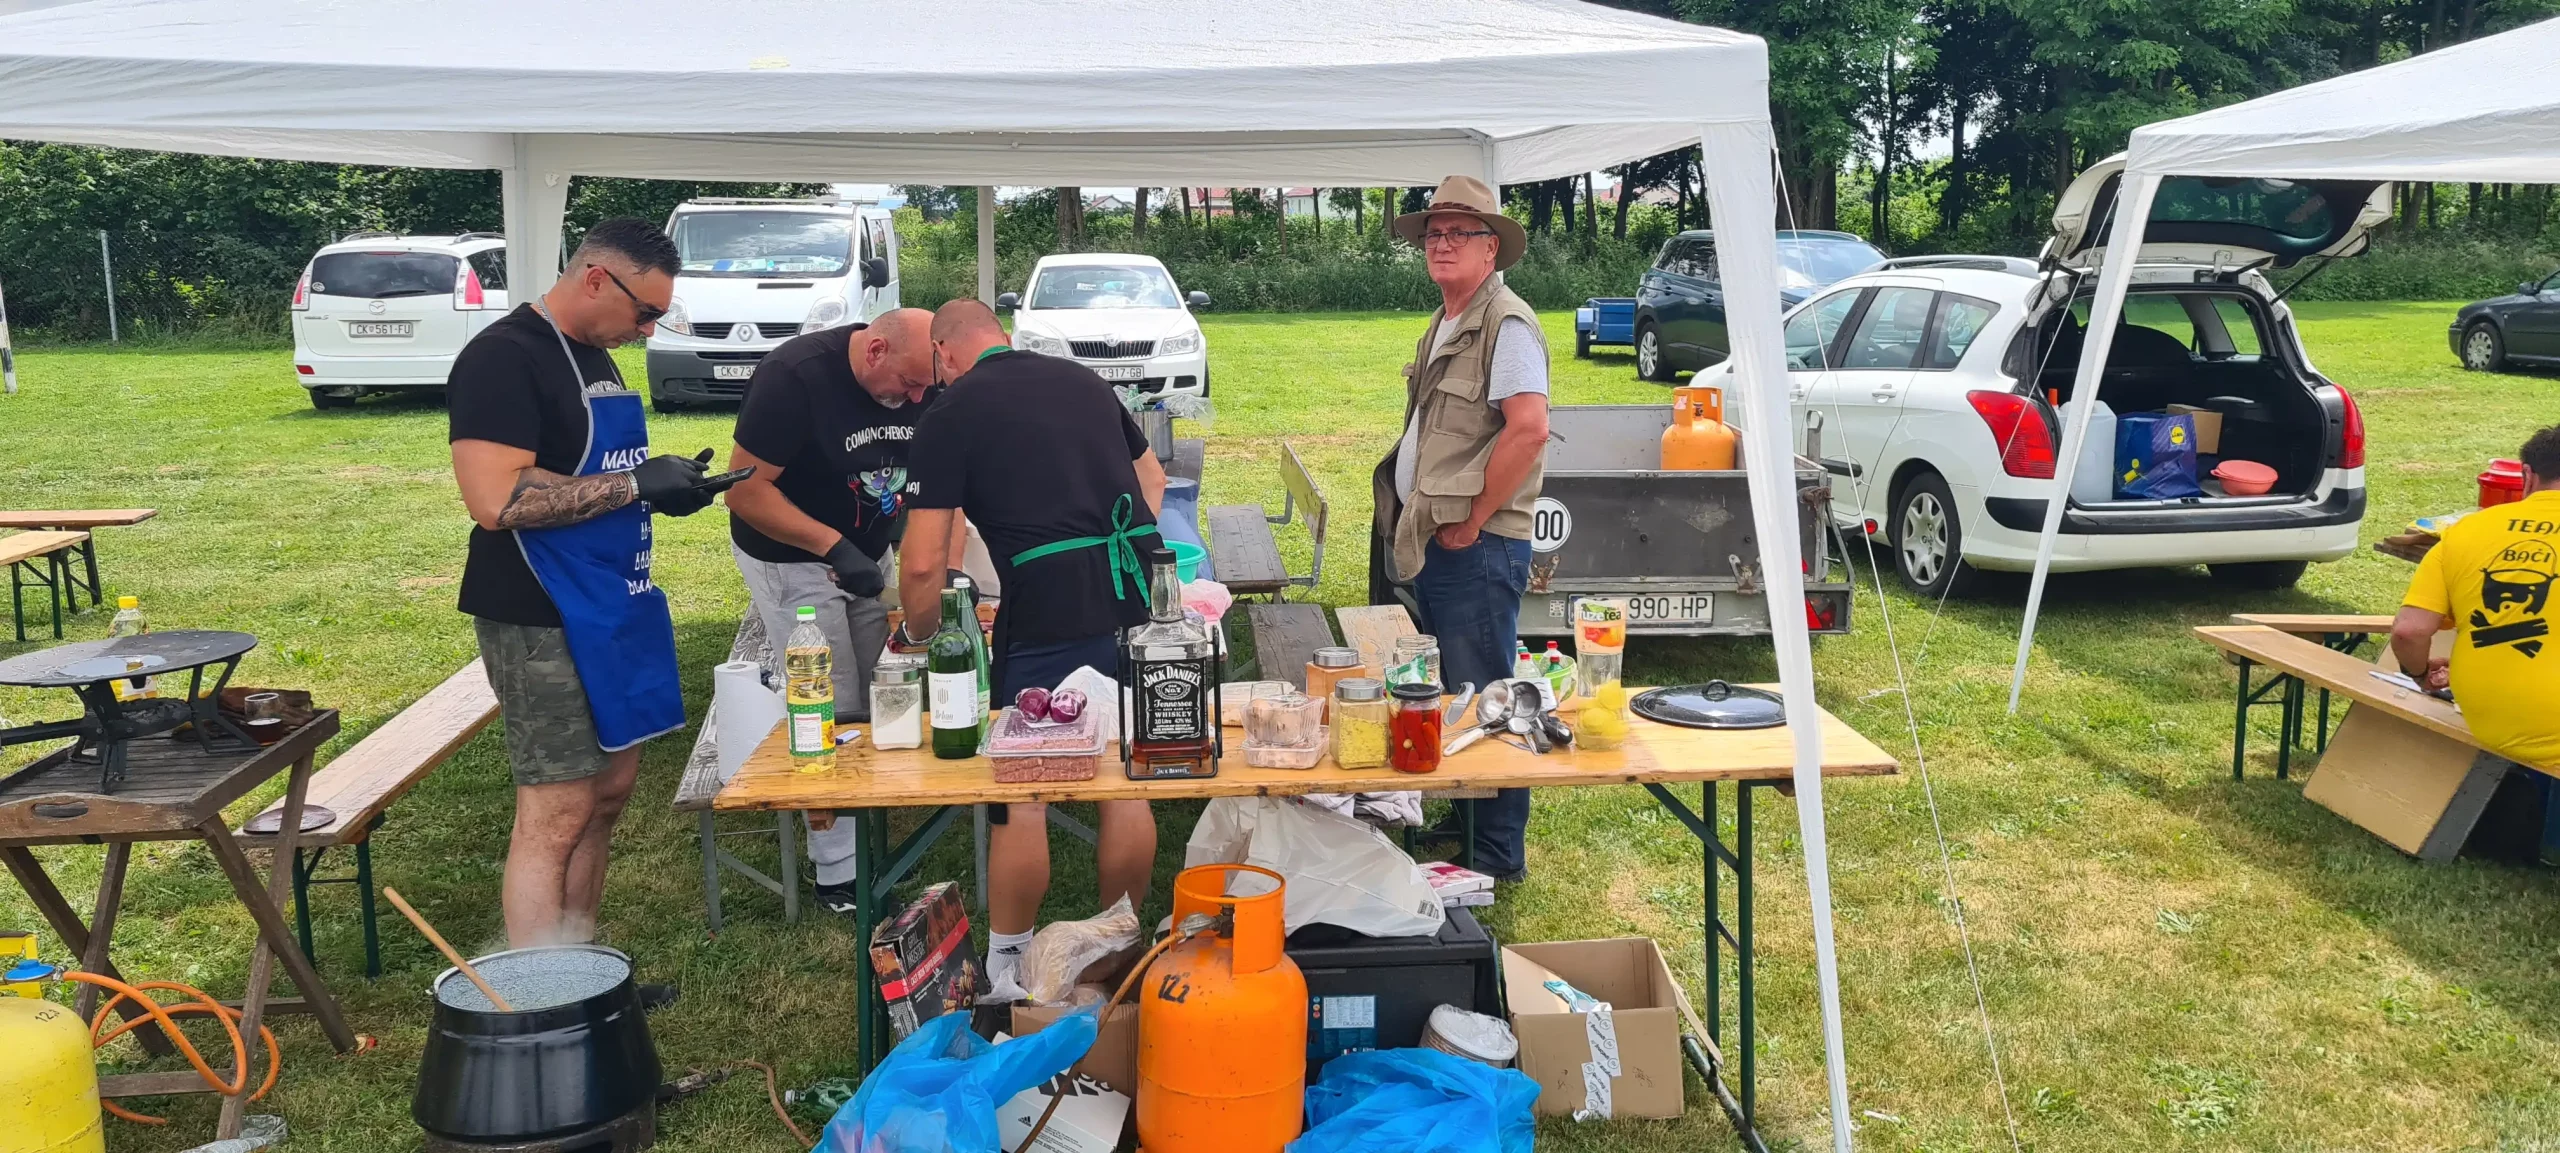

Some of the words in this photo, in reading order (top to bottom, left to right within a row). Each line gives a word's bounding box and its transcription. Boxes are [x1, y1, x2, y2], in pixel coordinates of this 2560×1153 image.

[356, 324, 369, 334] CK
[375, 324, 411, 334] 561-FU
[1534, 509, 1564, 541] 00
[2506, 518, 2560, 535] TEA
[1628, 597, 1708, 619] 990-HP
[1142, 669, 1167, 688] JACK
[1153, 699, 1193, 708] Tennessee
